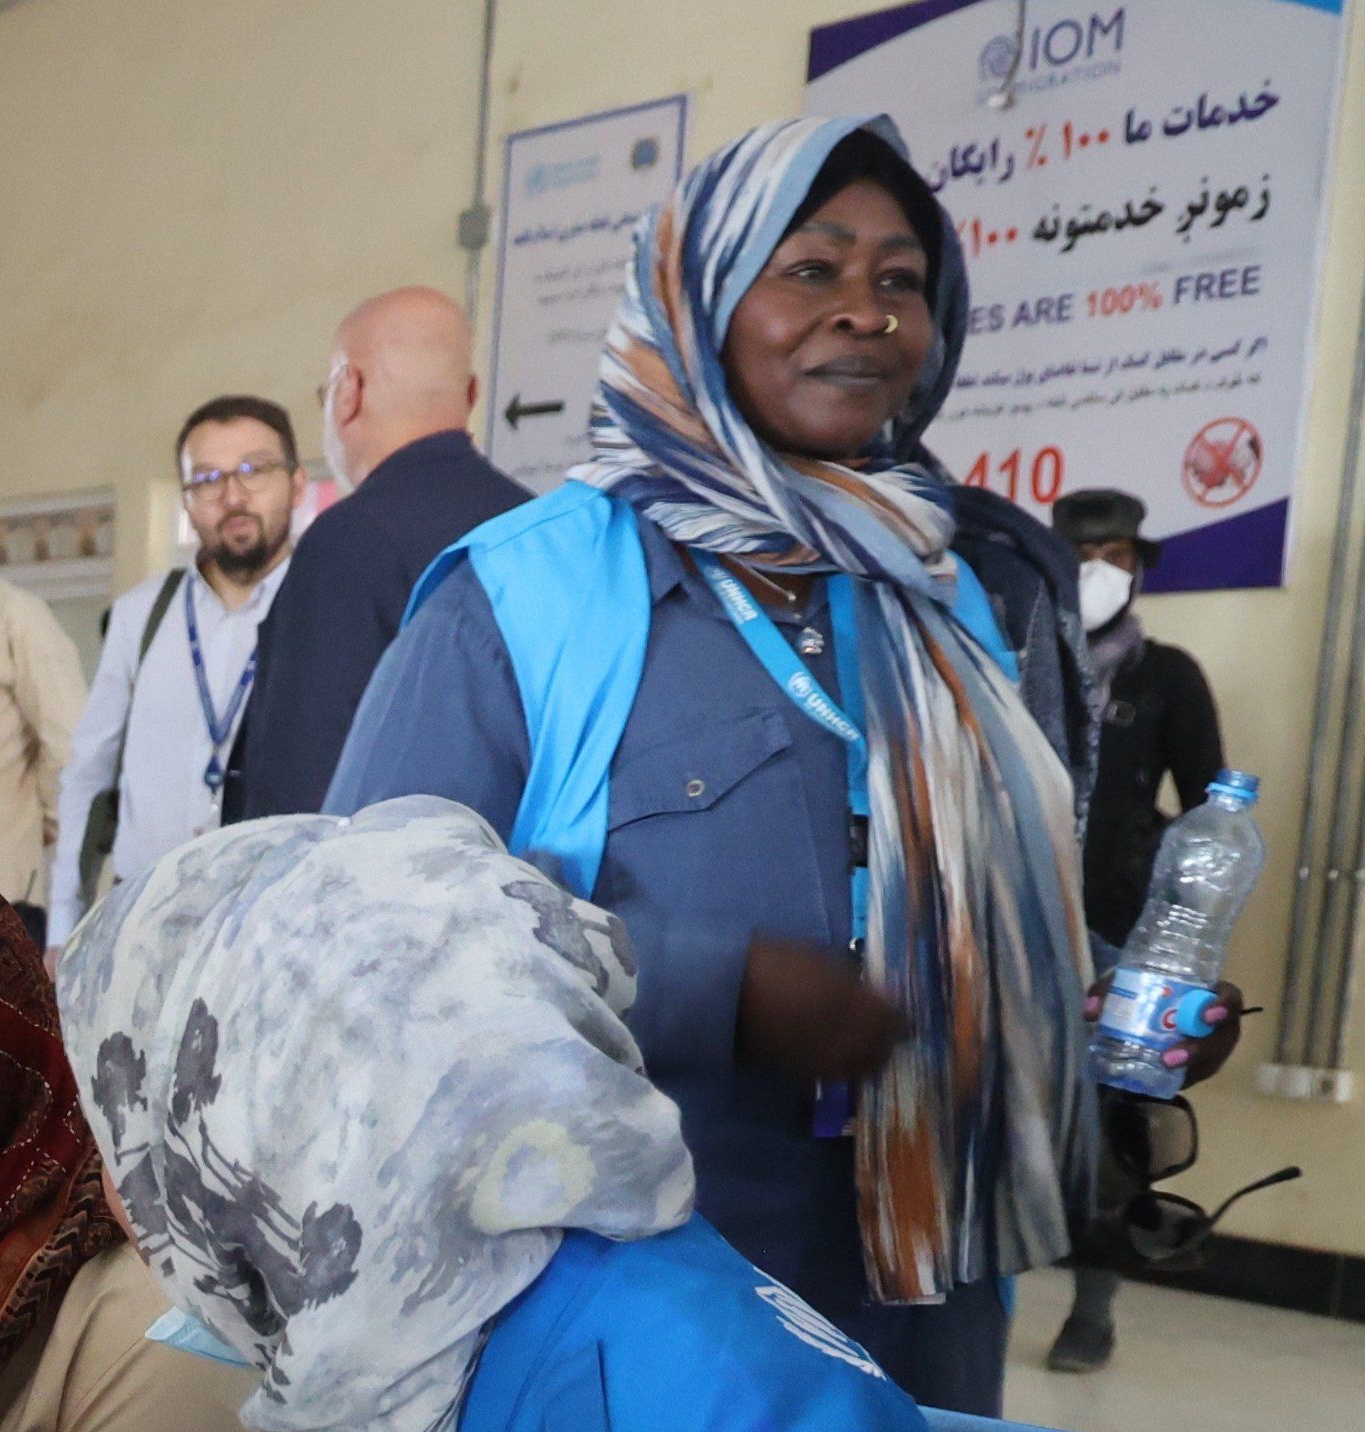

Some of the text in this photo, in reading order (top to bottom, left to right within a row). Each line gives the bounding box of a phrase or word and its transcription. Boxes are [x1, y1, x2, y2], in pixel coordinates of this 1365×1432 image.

[1028, 8, 1126, 71] IOM
[1162, 79, 1281, 138] خدمات
[1012, 293, 1074, 329] ARE
[1085, 281, 1164, 319] 100%
[1172, 264, 1263, 305] FREE
